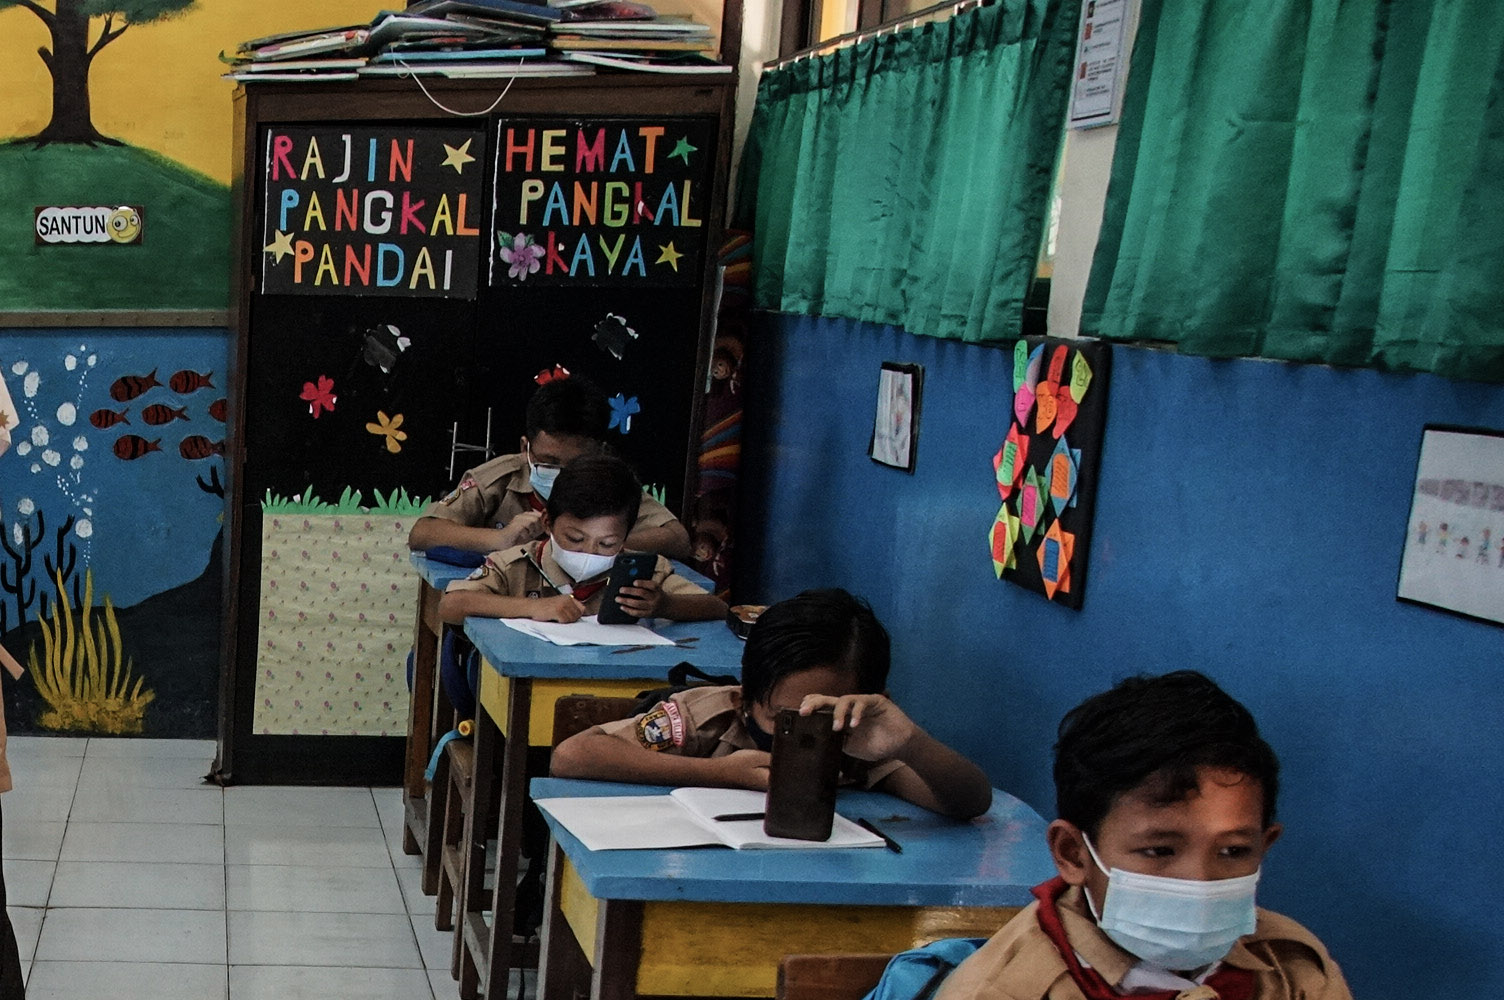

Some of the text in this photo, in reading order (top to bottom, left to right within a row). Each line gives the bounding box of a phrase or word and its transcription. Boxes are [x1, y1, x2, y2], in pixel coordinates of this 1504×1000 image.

[272, 134, 414, 183] RAJIN
[505, 126, 665, 174] HEMAT
[39, 214, 106, 236] SANTUN
[279, 188, 480, 236] PANGKAL
[519, 179, 702, 228] PANGKAL
[294, 240, 453, 290] PANDAI
[545, 231, 647, 277] KAYA
